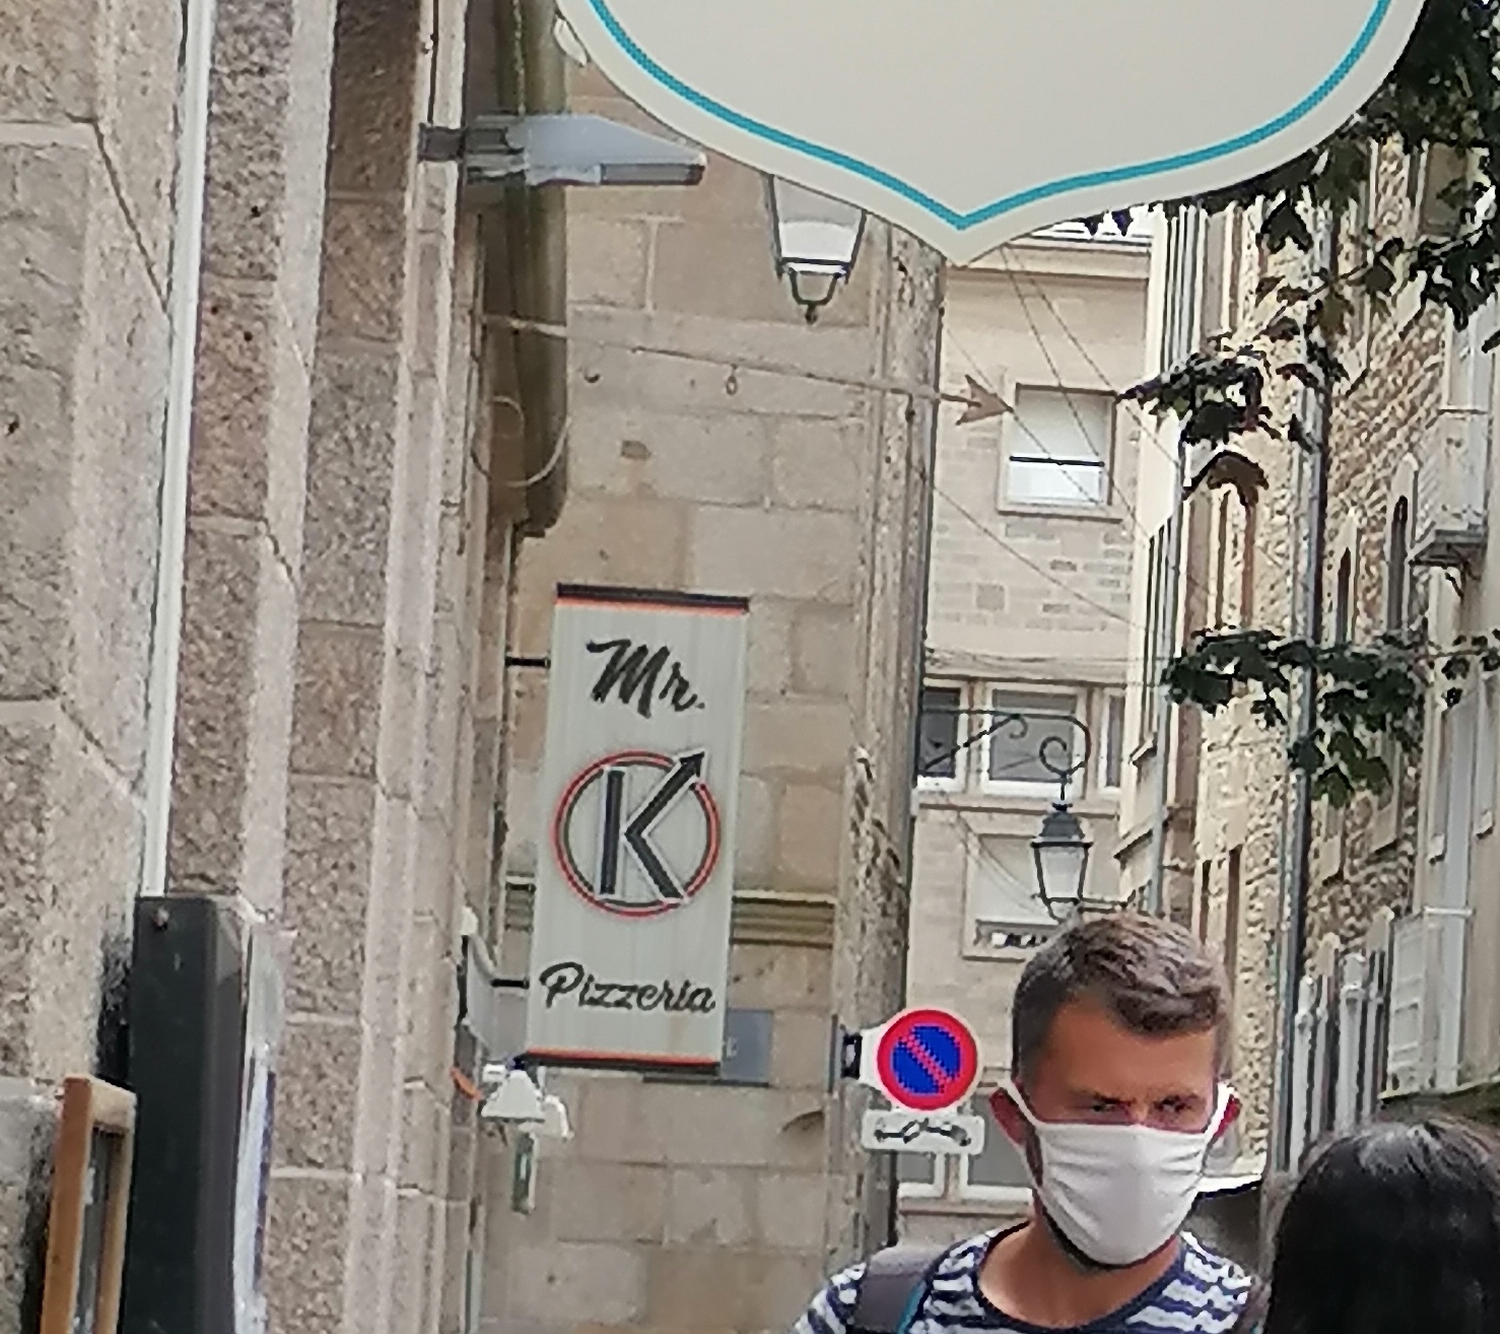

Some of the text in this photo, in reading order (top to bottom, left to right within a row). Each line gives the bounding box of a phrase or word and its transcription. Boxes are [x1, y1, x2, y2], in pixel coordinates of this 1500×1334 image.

[586, 638, 705, 718] Mr.
[599, 749, 706, 902] K
[539, 962, 716, 1014] Pizzeria
